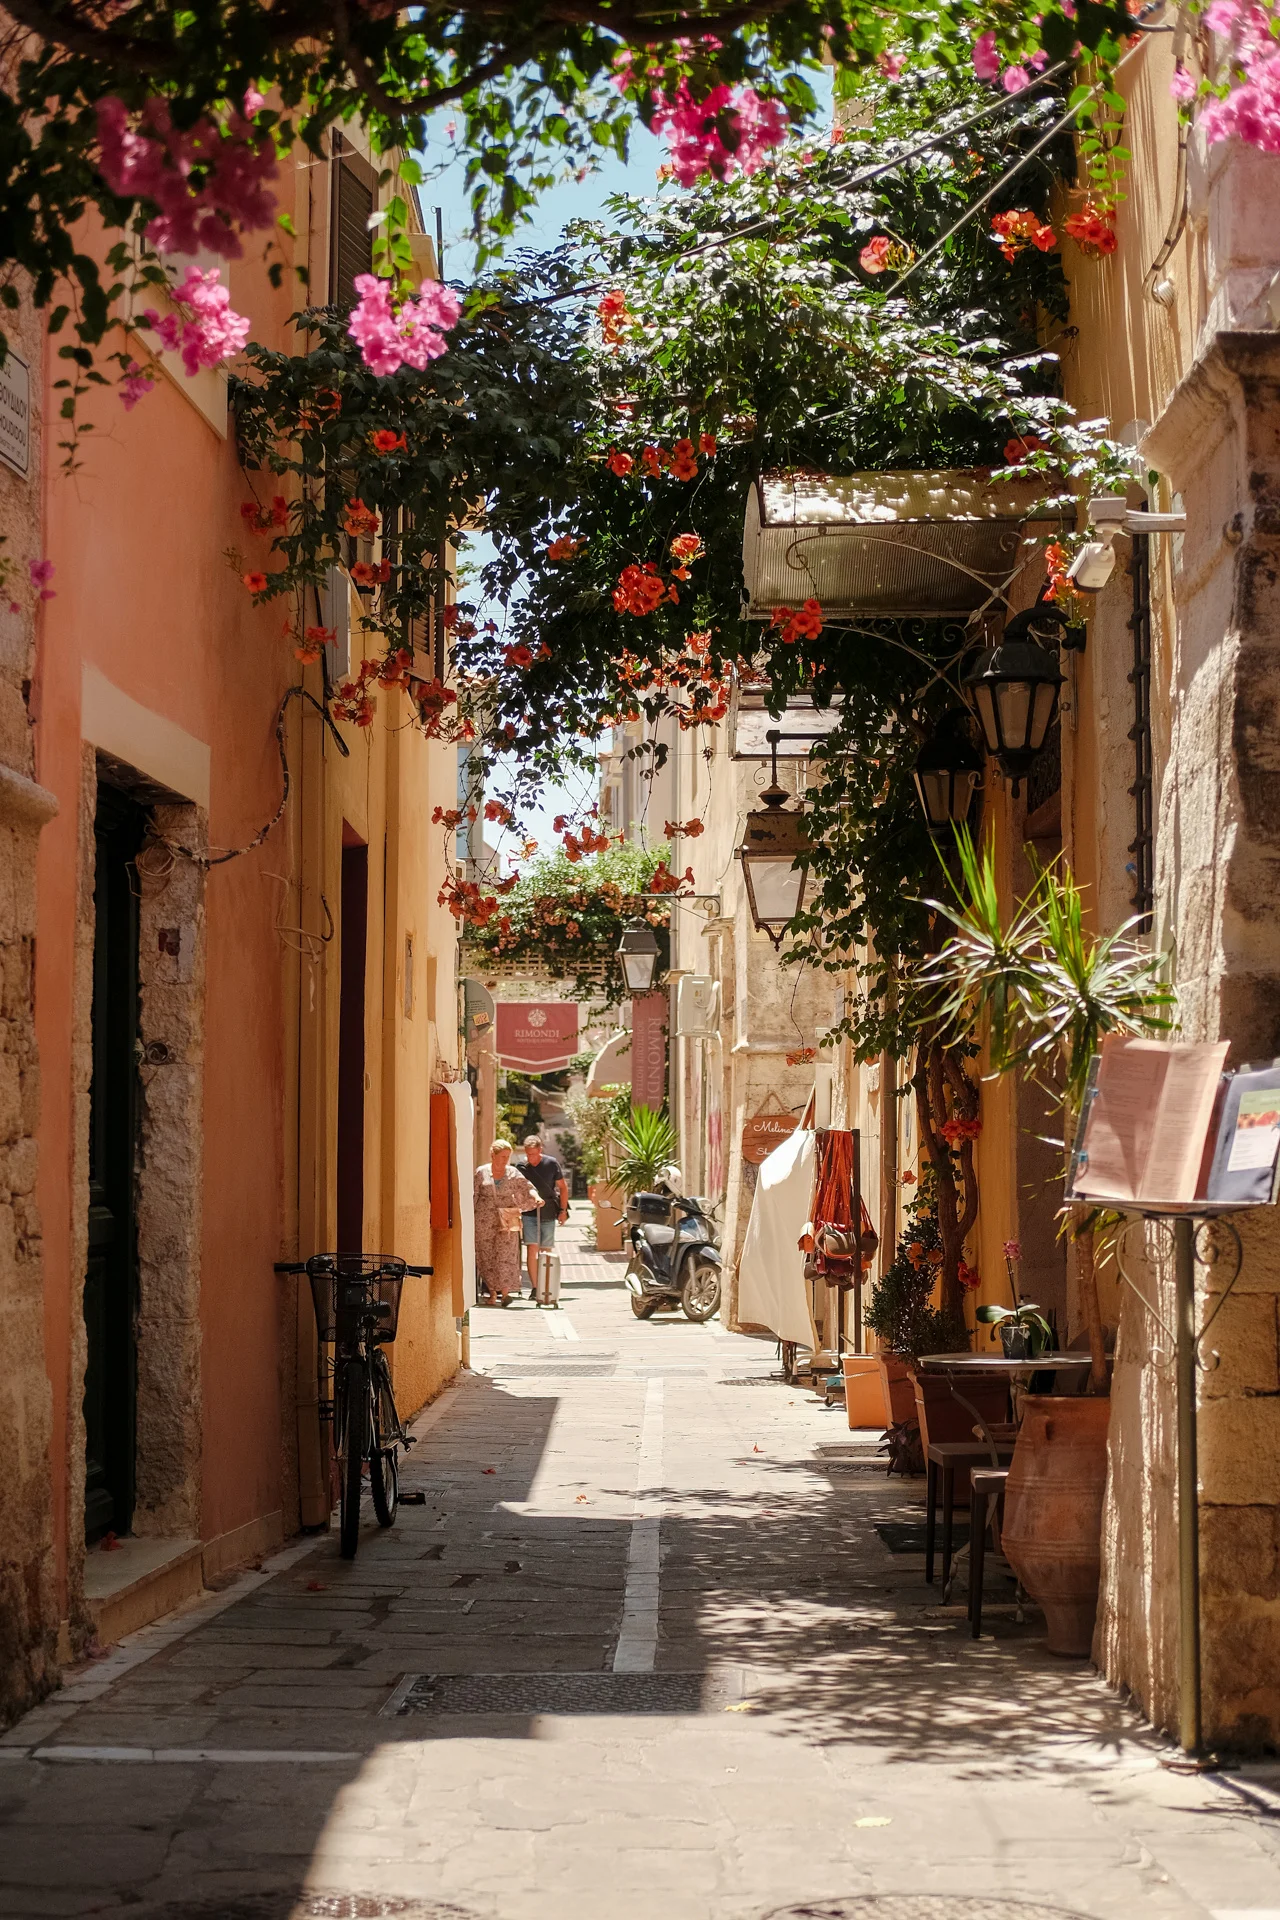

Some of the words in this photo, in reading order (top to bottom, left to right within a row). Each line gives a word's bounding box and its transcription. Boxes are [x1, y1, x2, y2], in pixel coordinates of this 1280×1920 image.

[515, 1029, 560, 1038] RIMONDI
[648, 1017, 661, 1102] RIMONDI
[636, 1066, 644, 1096] HOTELS
